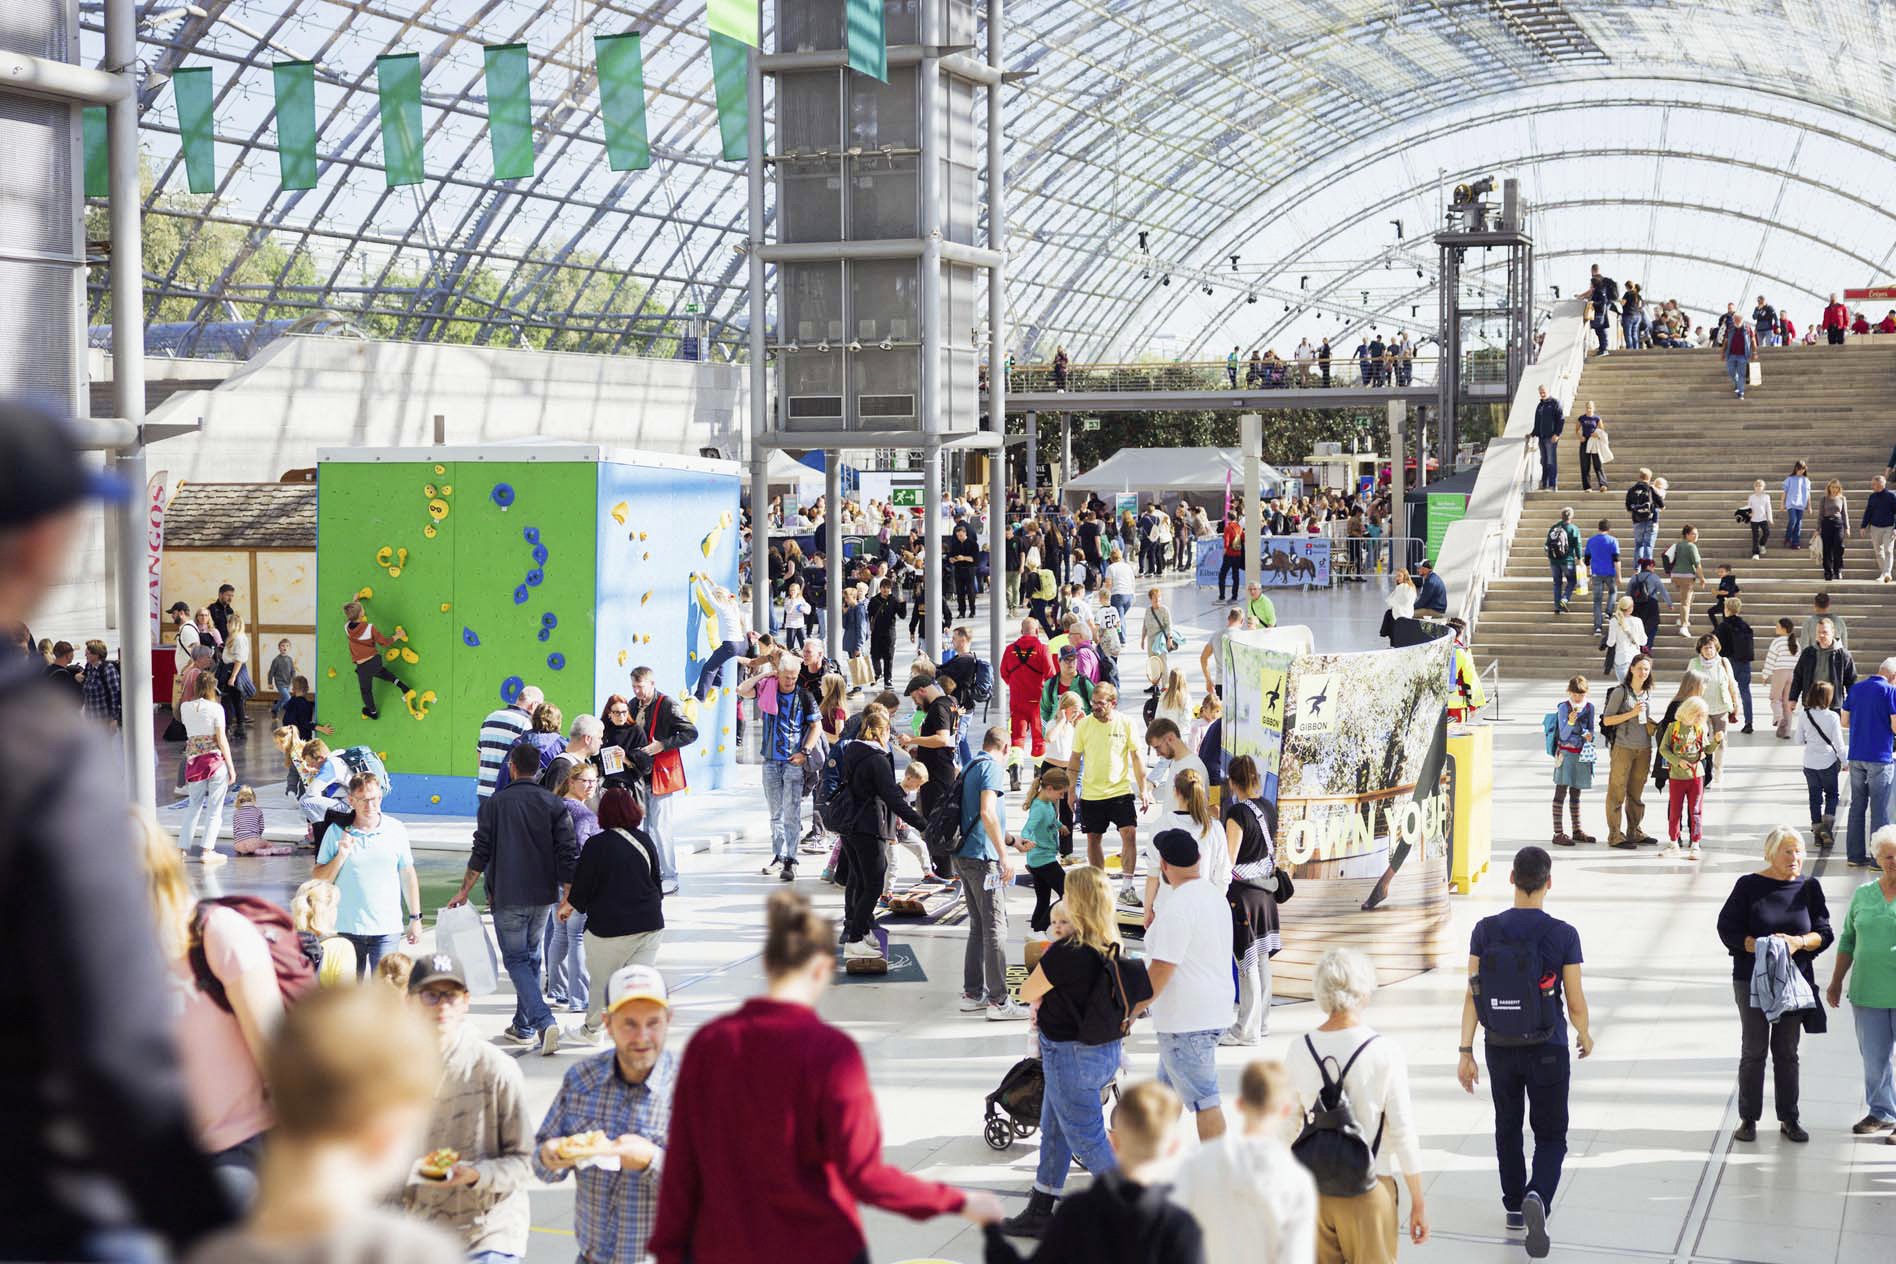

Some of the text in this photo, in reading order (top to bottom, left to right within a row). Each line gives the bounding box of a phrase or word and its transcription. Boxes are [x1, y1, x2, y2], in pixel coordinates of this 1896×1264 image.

[1262, 716, 1280, 728] GIBBON
[1299, 722, 1328, 732] GIBBON
[1286, 801, 1378, 865] OWN
